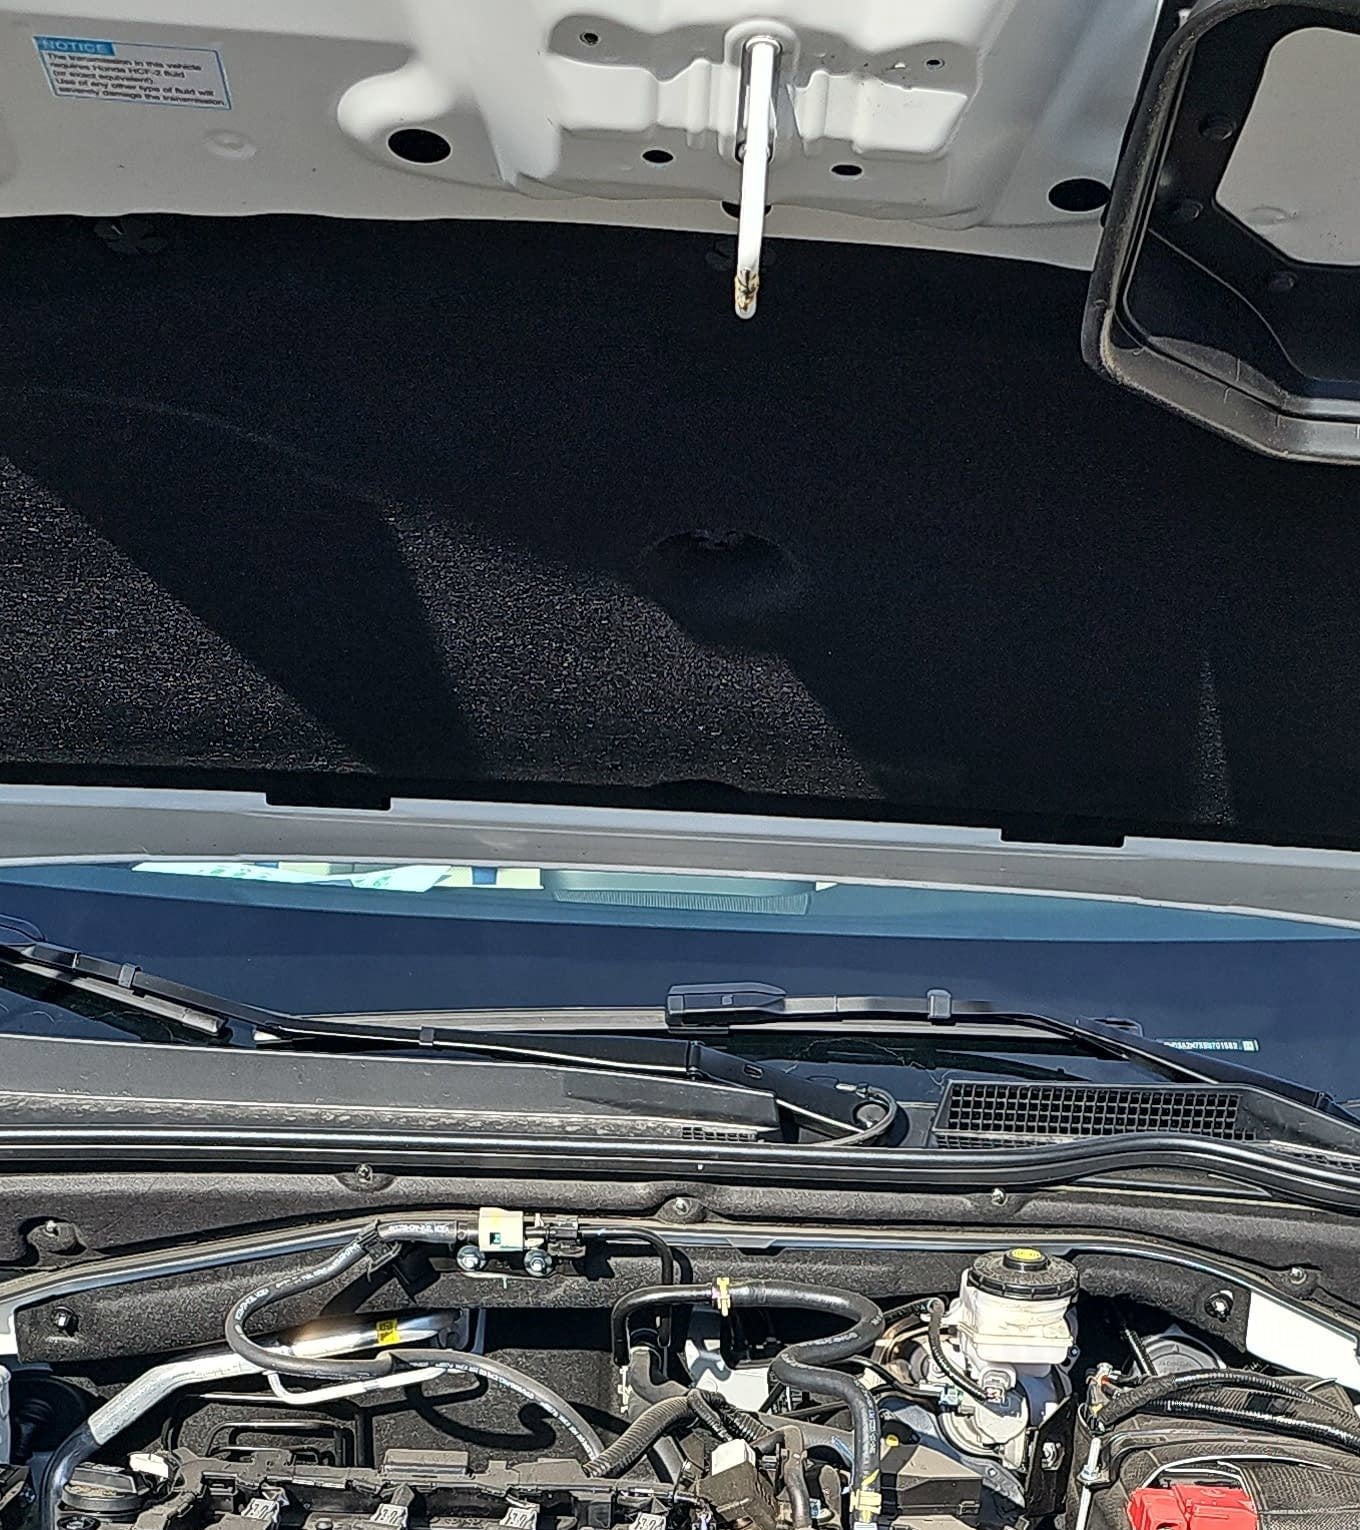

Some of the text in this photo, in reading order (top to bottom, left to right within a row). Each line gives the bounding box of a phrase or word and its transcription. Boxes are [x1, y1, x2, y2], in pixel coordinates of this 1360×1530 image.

[42, 40, 106, 53] NOTICE
[50, 62, 185, 78] requires Honda HCF-2 fluid
[146, 61, 165, 69] this
[167, 63, 202, 71] vehicle
[55, 78, 76, 86] Use
[78, 79, 88, 87] of
[90, 81, 109, 89] any
[111, 82, 137, 90] other
[138, 85, 161, 93] type
[175, 87, 196, 95] fluid
[198, 89, 214, 97] will
[102, 90, 142, 100] damage
[144, 93, 161, 101] the
